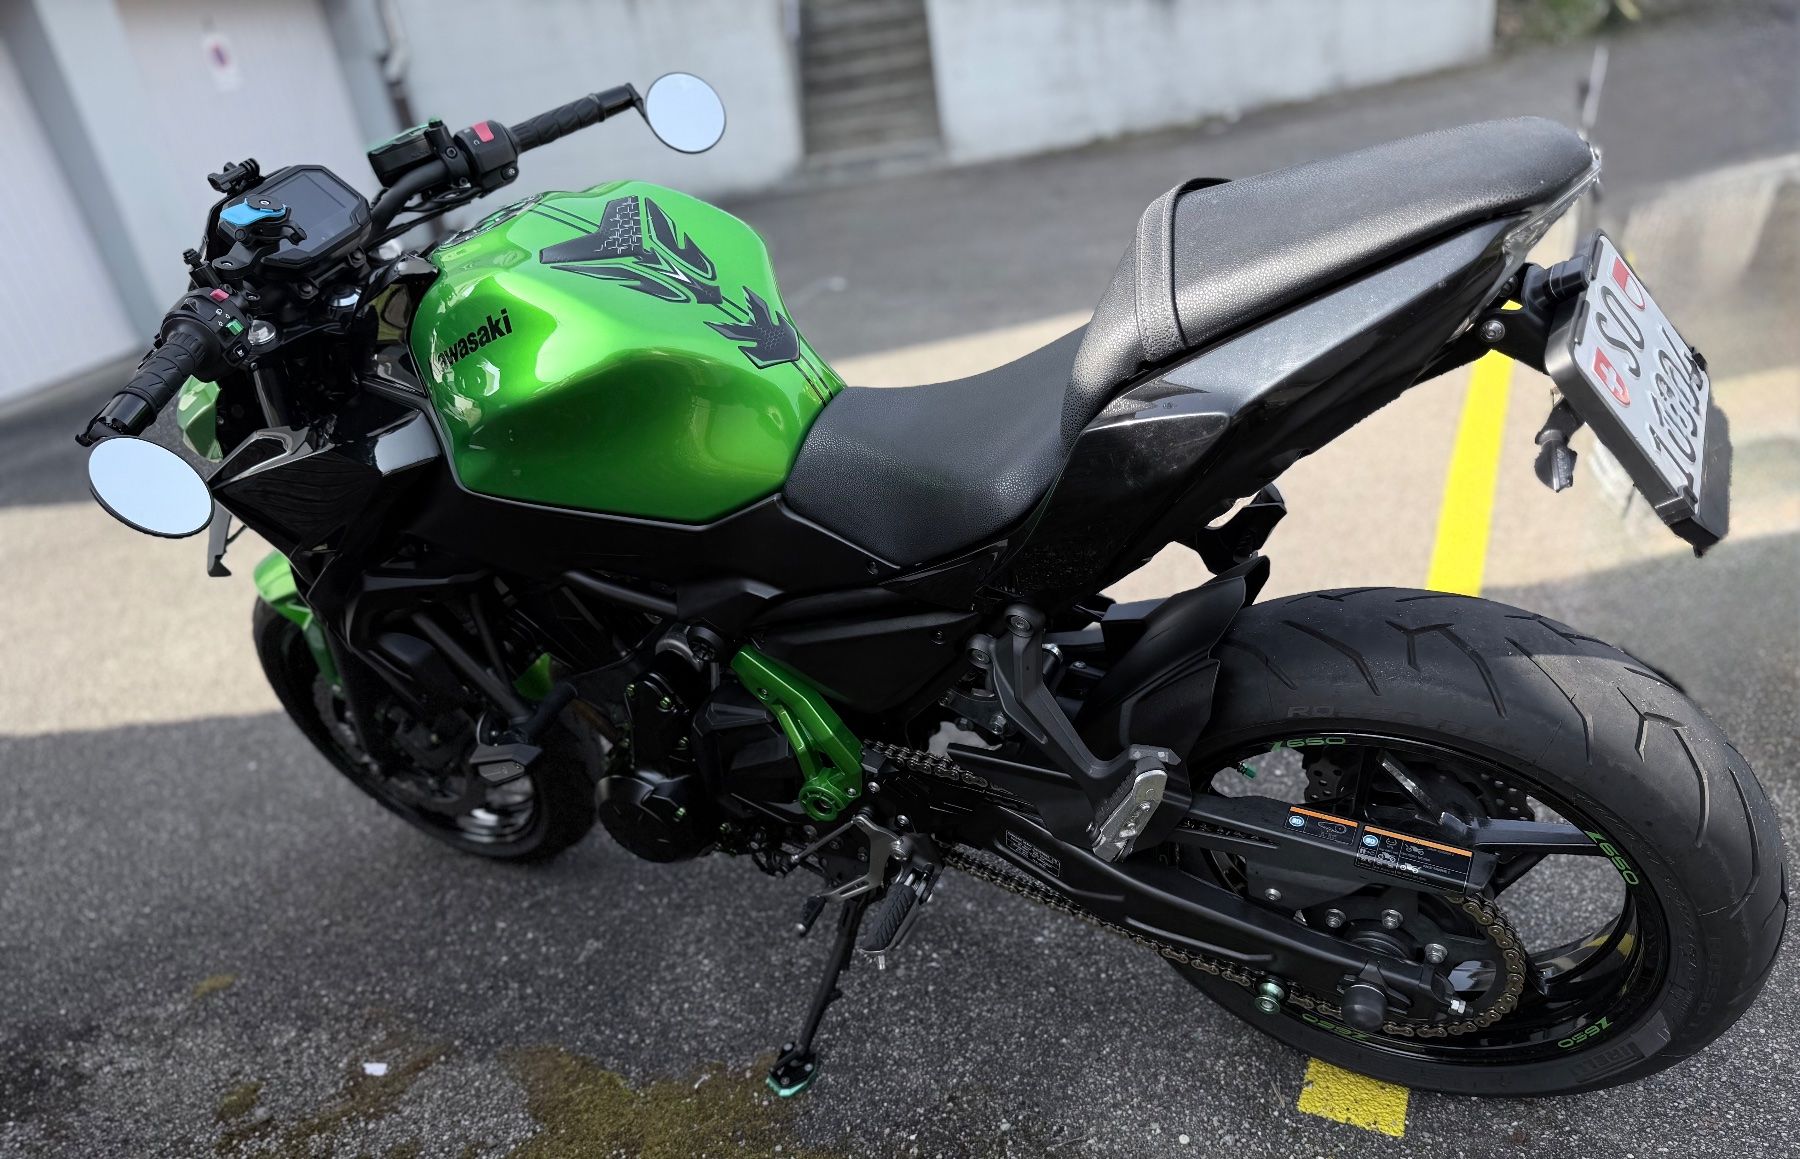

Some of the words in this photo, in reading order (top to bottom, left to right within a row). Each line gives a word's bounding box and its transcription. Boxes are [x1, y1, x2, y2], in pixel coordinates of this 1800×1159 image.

[428, 307, 512, 381] awasaki
[1595, 285, 1645, 378] SO
[1584, 830, 1640, 885] Z650
[1557, 1016, 1614, 1048] Z650
